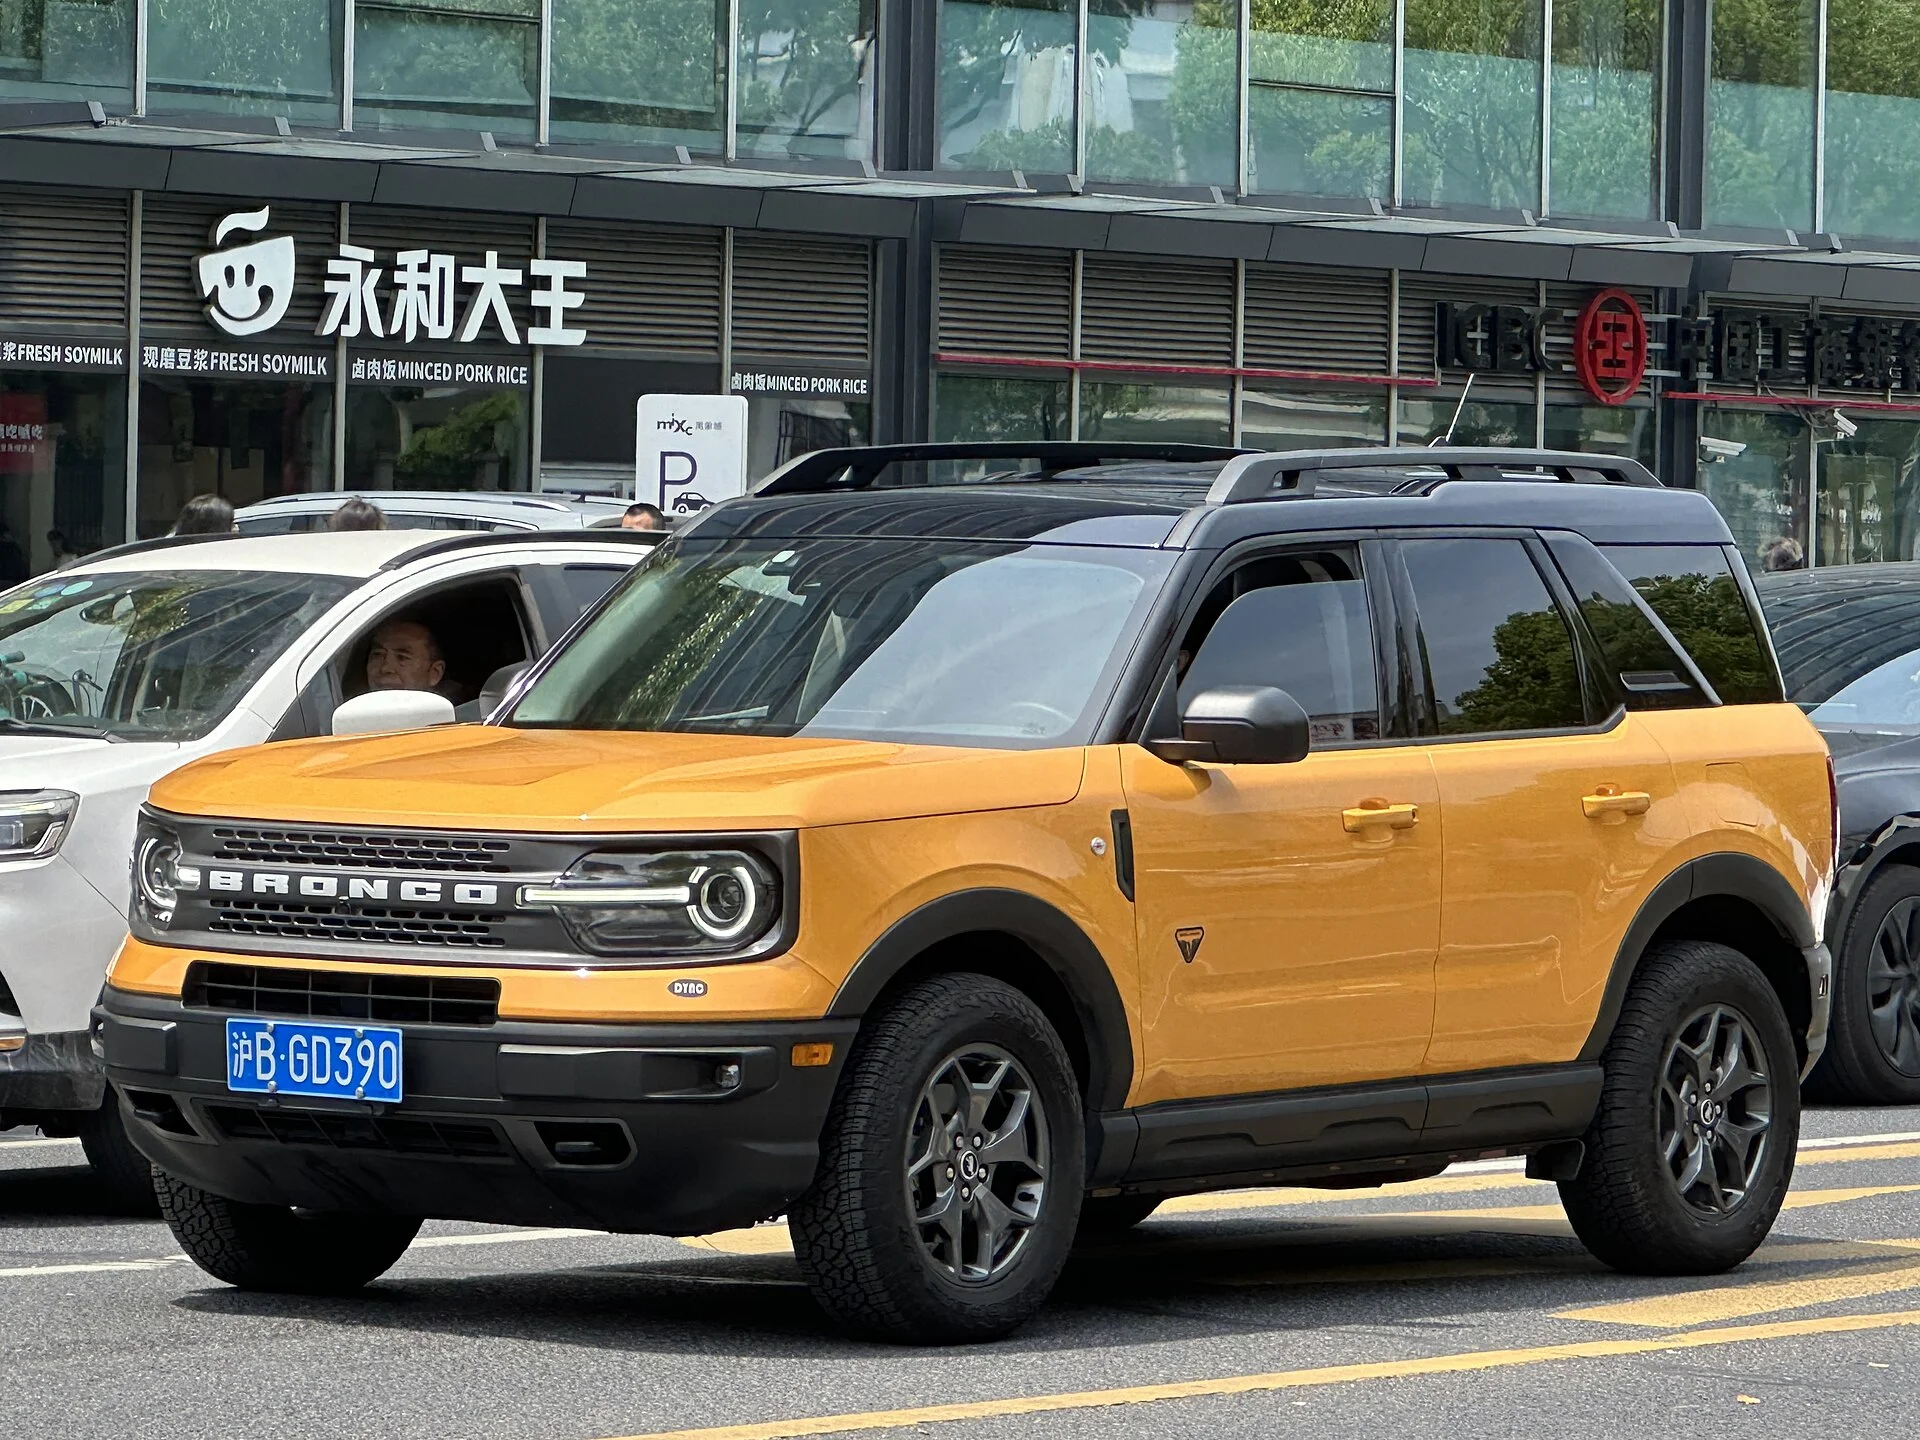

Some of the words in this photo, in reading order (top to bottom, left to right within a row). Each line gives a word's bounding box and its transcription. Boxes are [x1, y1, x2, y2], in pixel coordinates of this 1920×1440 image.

[321, 244, 587, 346] 永和大王
[64, 346, 123, 365] SOYMILK
[262, 353, 328, 376] SOYMILK
[455, 363, 494, 384] PORK
[496, 365, 528, 385] RICE
[810, 377, 841, 393] PORK
[842, 379, 867, 394] RICE
[659, 451, 698, 512] P
[209, 870, 498, 905] BRONCO
